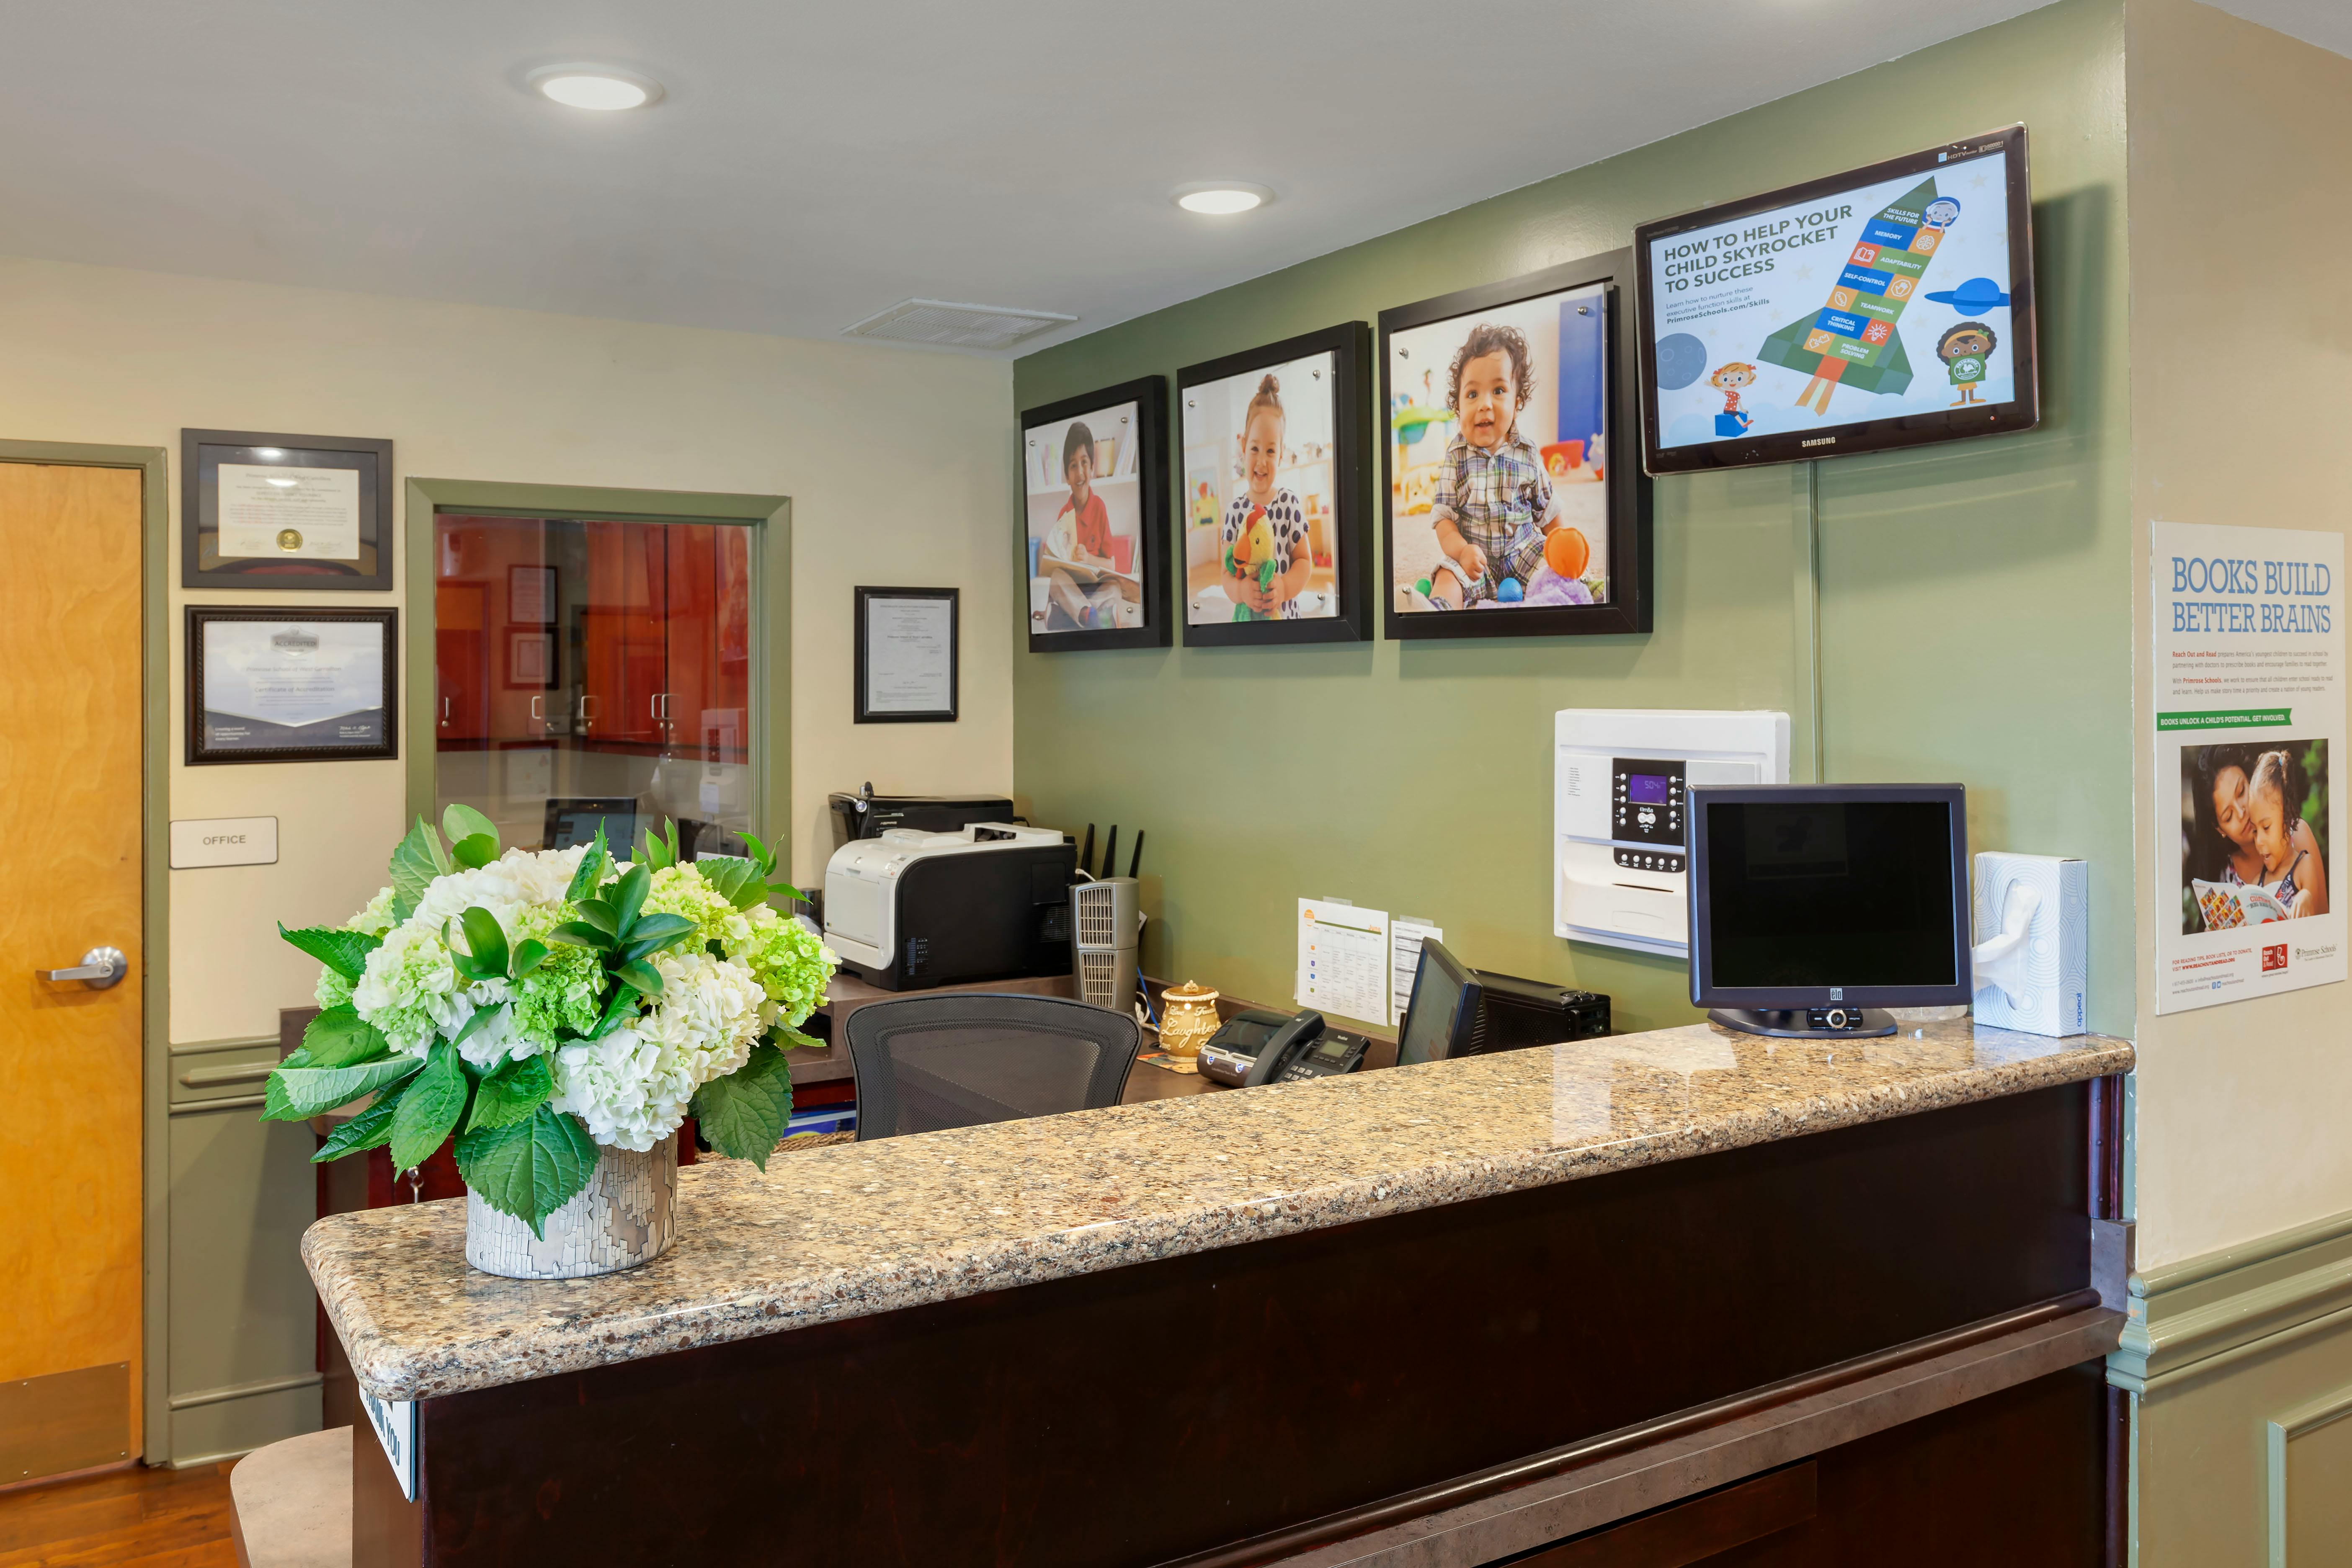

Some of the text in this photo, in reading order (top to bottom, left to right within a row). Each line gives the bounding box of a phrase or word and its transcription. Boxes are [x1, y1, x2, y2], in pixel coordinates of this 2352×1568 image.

[1947, 151, 1967, 160] HDTV
[1887, 208, 1906, 216] SKILLS
[1894, 215, 1918, 224] FUTURE
[1664, 205, 1852, 261] HOW TO HELP YOUR
[1875, 230, 1902, 240] MEMORY
[1665, 225, 1838, 277] CHILD SKYROCKET
[1880, 257, 1922, 270] ADAPTABILITY
[1665, 258, 1775, 293] TO SUCCESS
[1844, 273, 1886, 286] SELF-CONTROL
[1666, 300, 1684, 309] Learn
[1685, 297, 1700, 305] how
[1709, 291, 1733, 300] nurture
[1734, 286, 1754, 295] these
[1666, 306, 1697, 317] executive
[1698, 300, 1725, 311] function
[1726, 297, 1743, 305] skills
[1667, 298, 1770, 324] PrimroseSchools.com/Skills
[1860, 302, 1895, 315] TEAMWORK
[1827, 320, 1854, 331] THINKING
[1831, 316, 1855, 326] CRITICAL
[1840, 348, 1865, 359] SOLVING
[1841, 343, 1869, 354] PROBLEM
[1802, 437, 1836, 448] SAMSUNG
[2172, 557, 2330, 596] BOOKS BUILD
[2172, 602, 2331, 633] BETTER BRAINS
[203, 835, 246, 845] OFFICE
[386, 1416, 400, 1466] YOU
